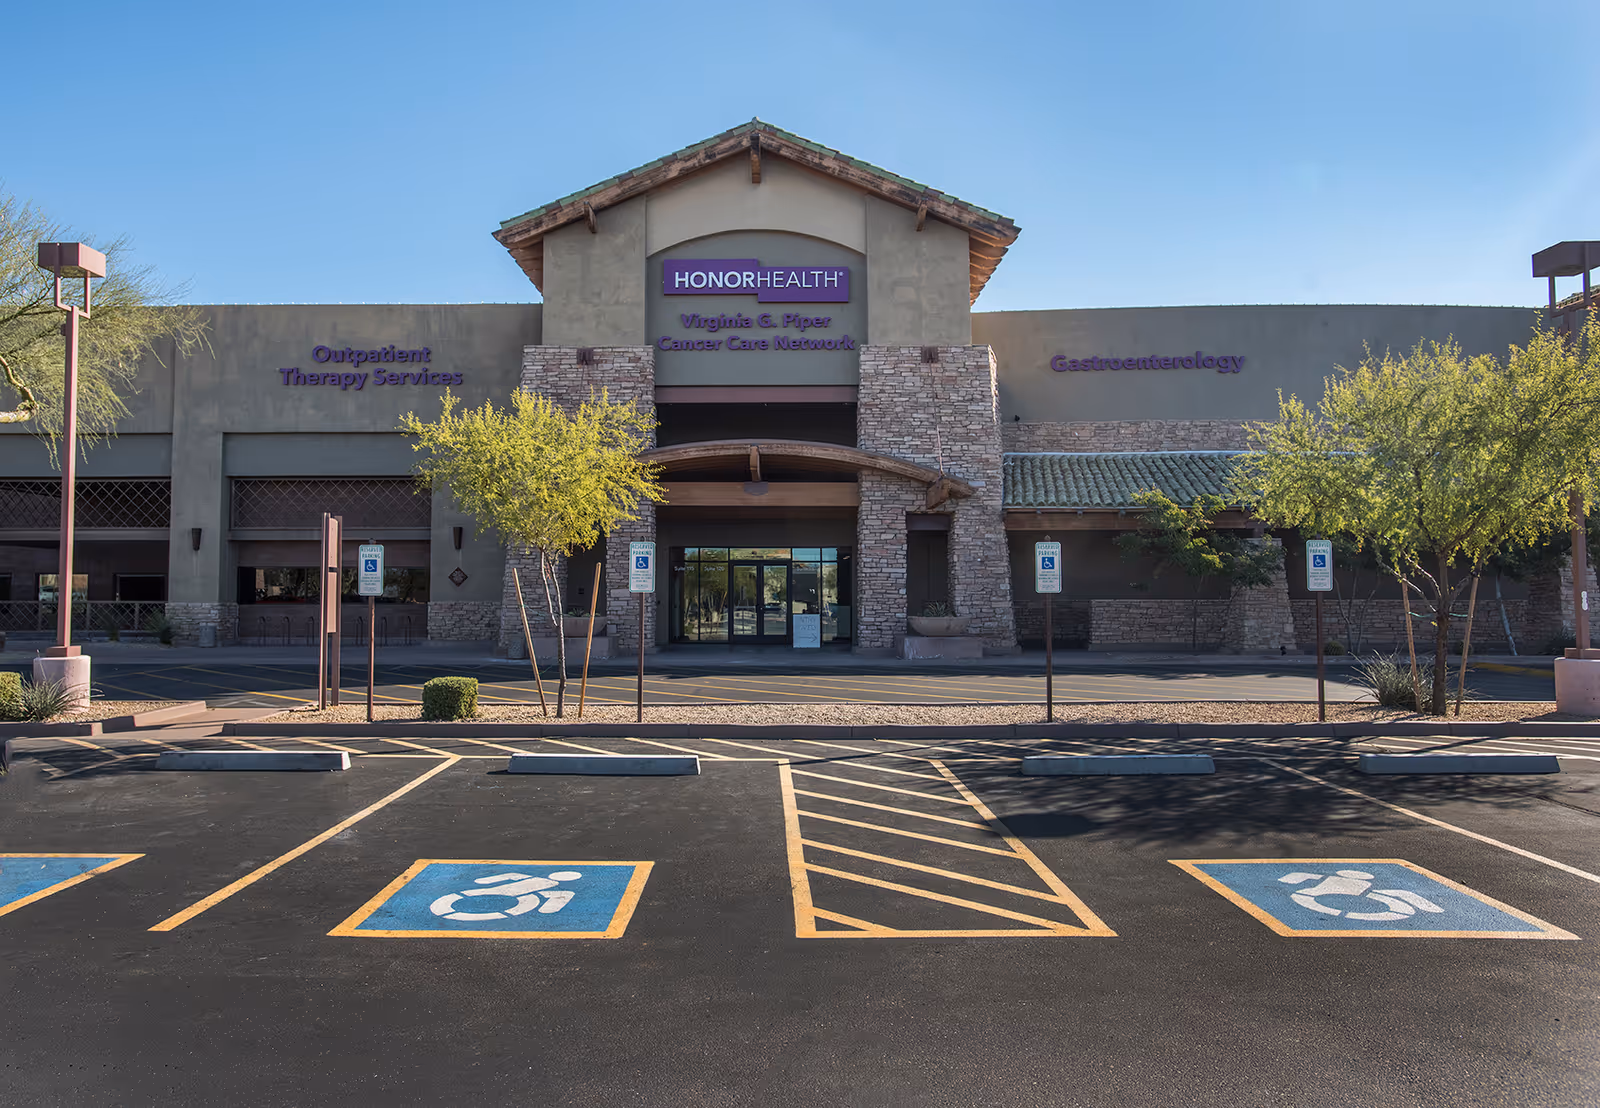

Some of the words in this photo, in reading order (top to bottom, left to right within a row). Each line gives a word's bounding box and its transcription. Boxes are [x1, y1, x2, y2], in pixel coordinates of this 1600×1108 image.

[674, 271, 838, 288] HONORHEALTH
[681, 312, 752, 332] Virginia
[758, 314, 777, 328] G.
[783, 313, 831, 332] Piper
[658, 336, 722, 350] Cancer
[727, 335, 769, 350] Care
[774, 335, 854, 350] Network
[312, 344, 431, 367] Outpatient
[1050, 351, 1245, 373] Gastroenterology
[280, 367, 367, 390] Therapy
[373, 368, 463, 385] Services
